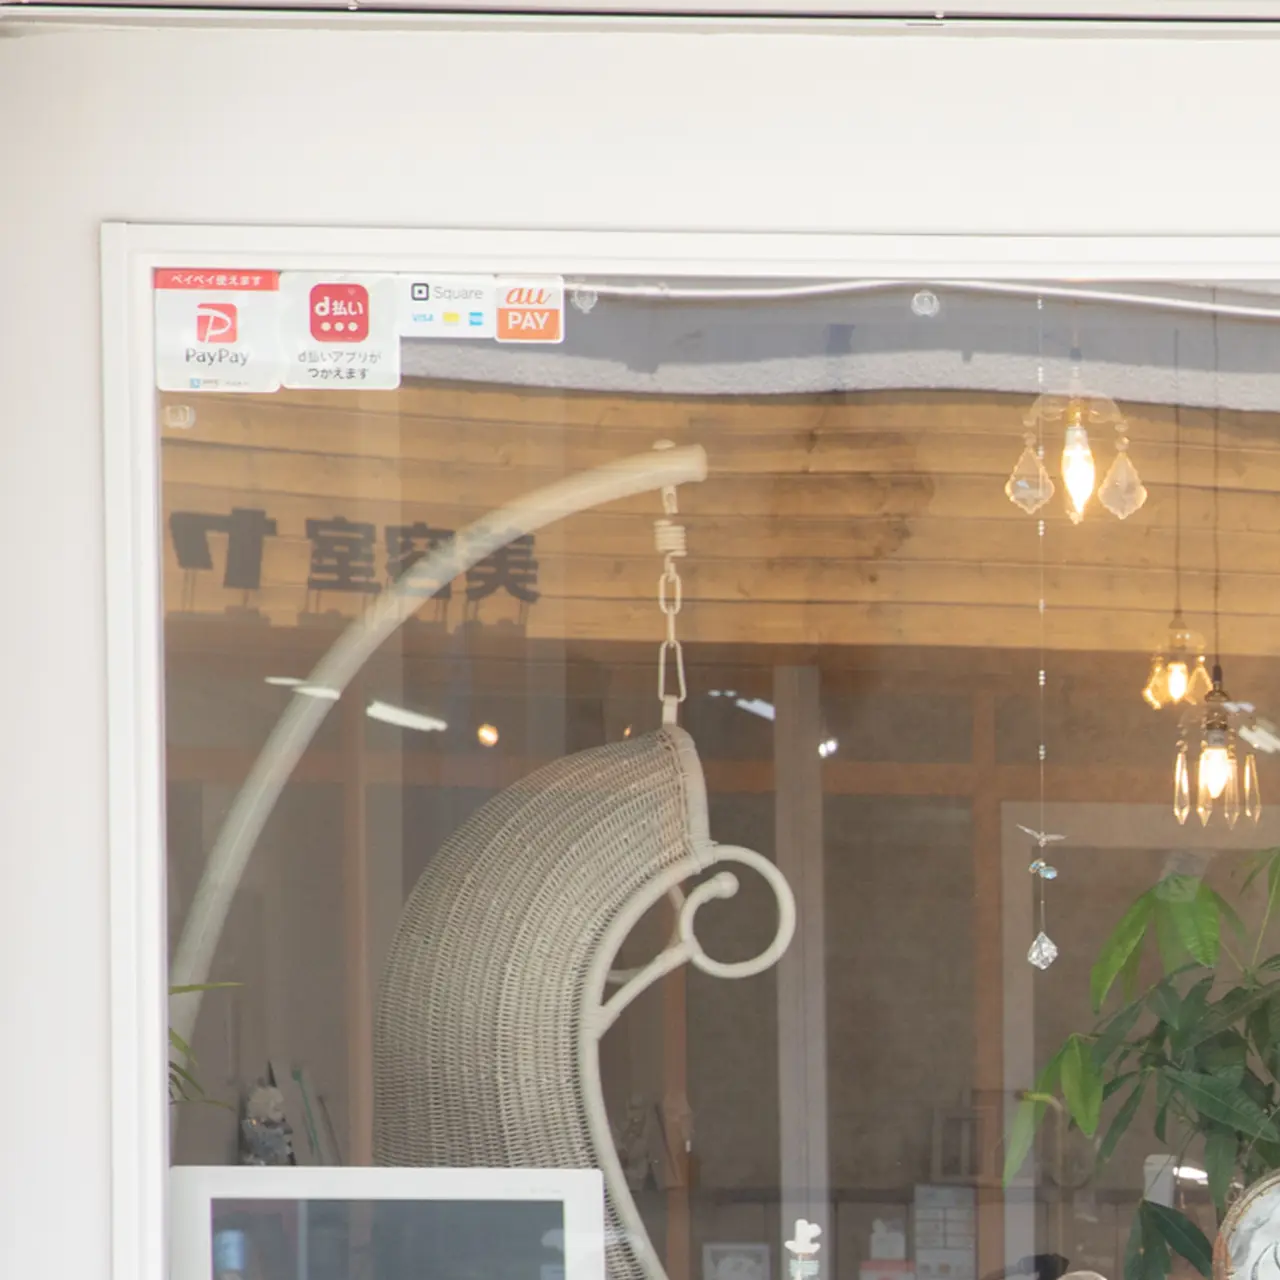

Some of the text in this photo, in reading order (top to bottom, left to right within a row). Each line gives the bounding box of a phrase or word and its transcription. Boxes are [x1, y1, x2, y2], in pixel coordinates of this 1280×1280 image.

[433, 286, 484, 300] Square
[505, 287, 552, 305] au
[314, 295, 365, 317] d払い
[507, 311, 550, 331] PAY
[184, 347, 250, 367] PayPay
[297, 350, 382, 364] d払いアプリが
[307, 367, 370, 380] つかえます
